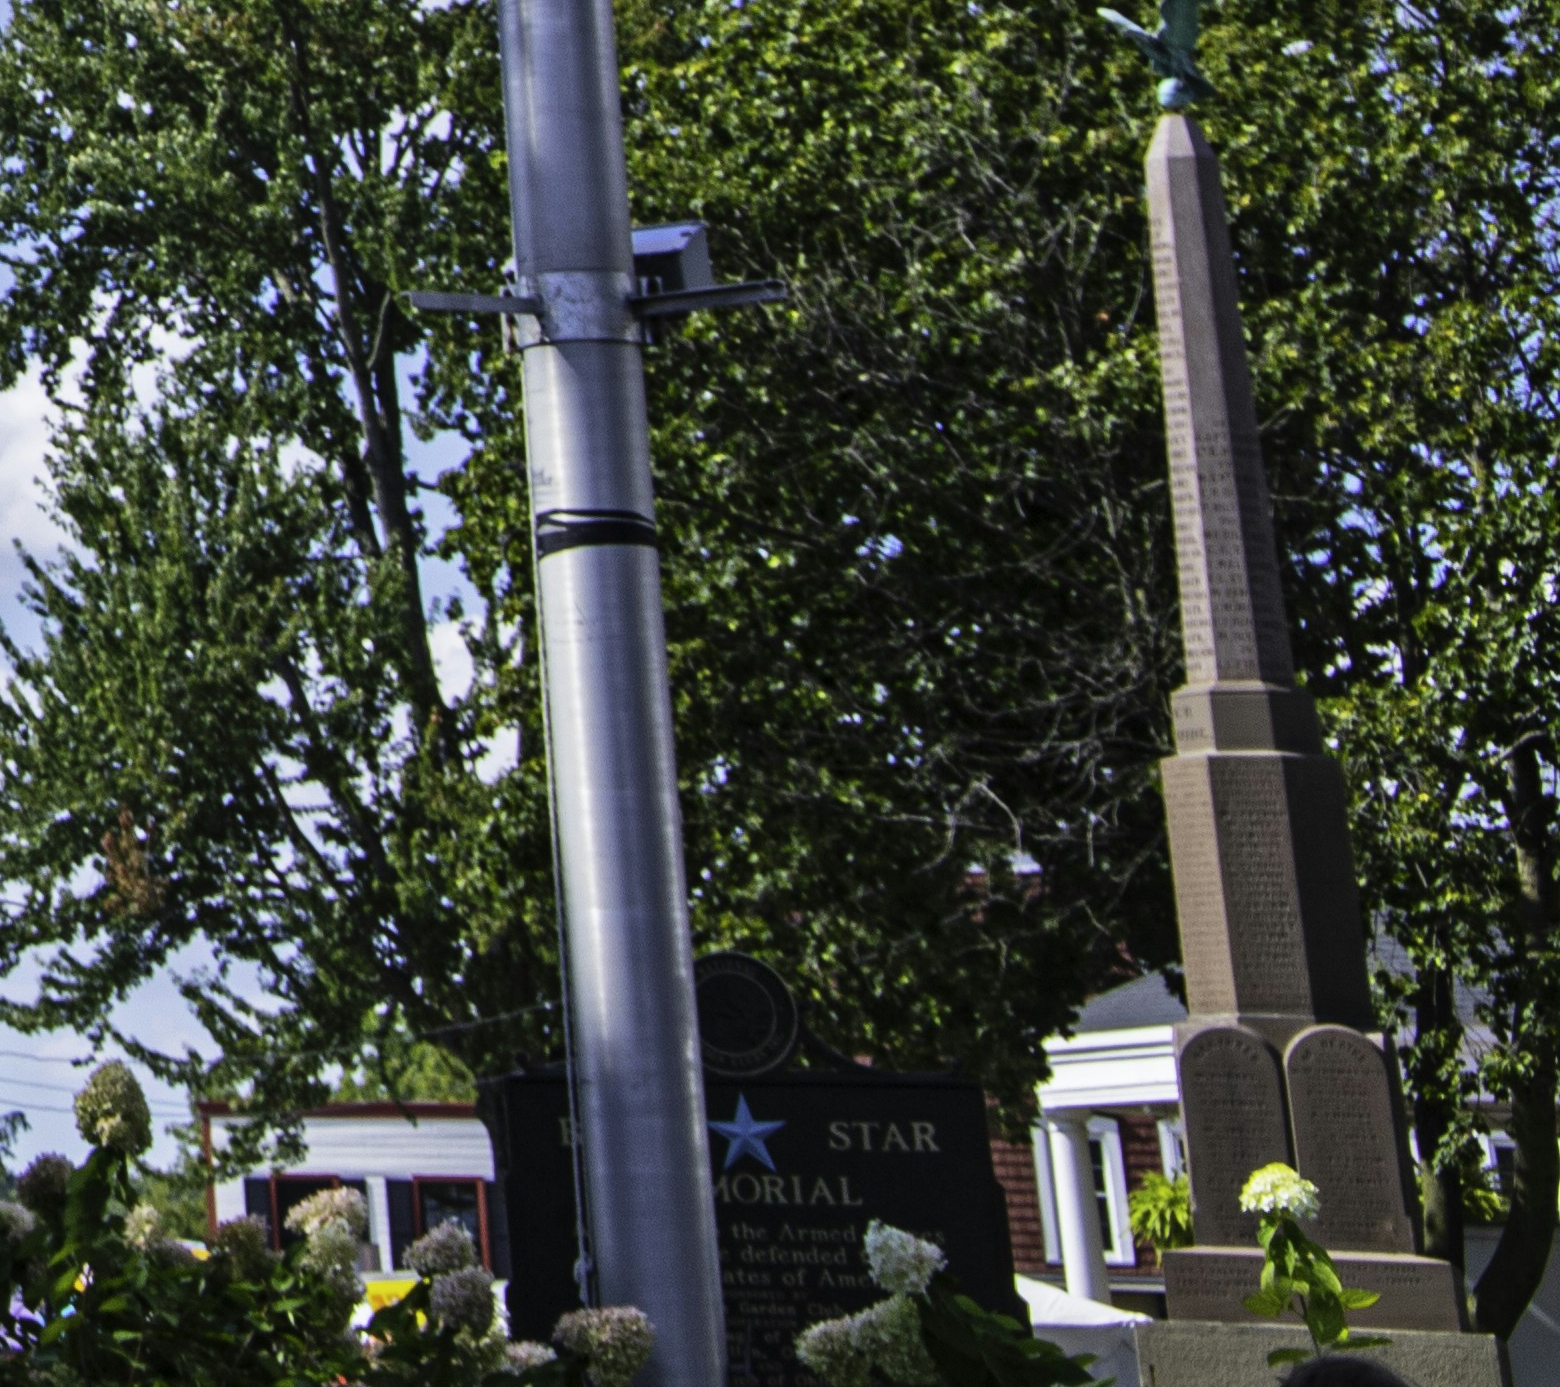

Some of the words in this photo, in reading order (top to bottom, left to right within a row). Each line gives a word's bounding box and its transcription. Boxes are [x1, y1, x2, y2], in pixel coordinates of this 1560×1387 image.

[828, 1121, 941, 1153] STAR
[731, 1222, 768, 1241] the
[778, 1222, 857, 1243] Armed
[740, 1245, 848, 1266] defended
[781, 1267, 808, 1287] of
